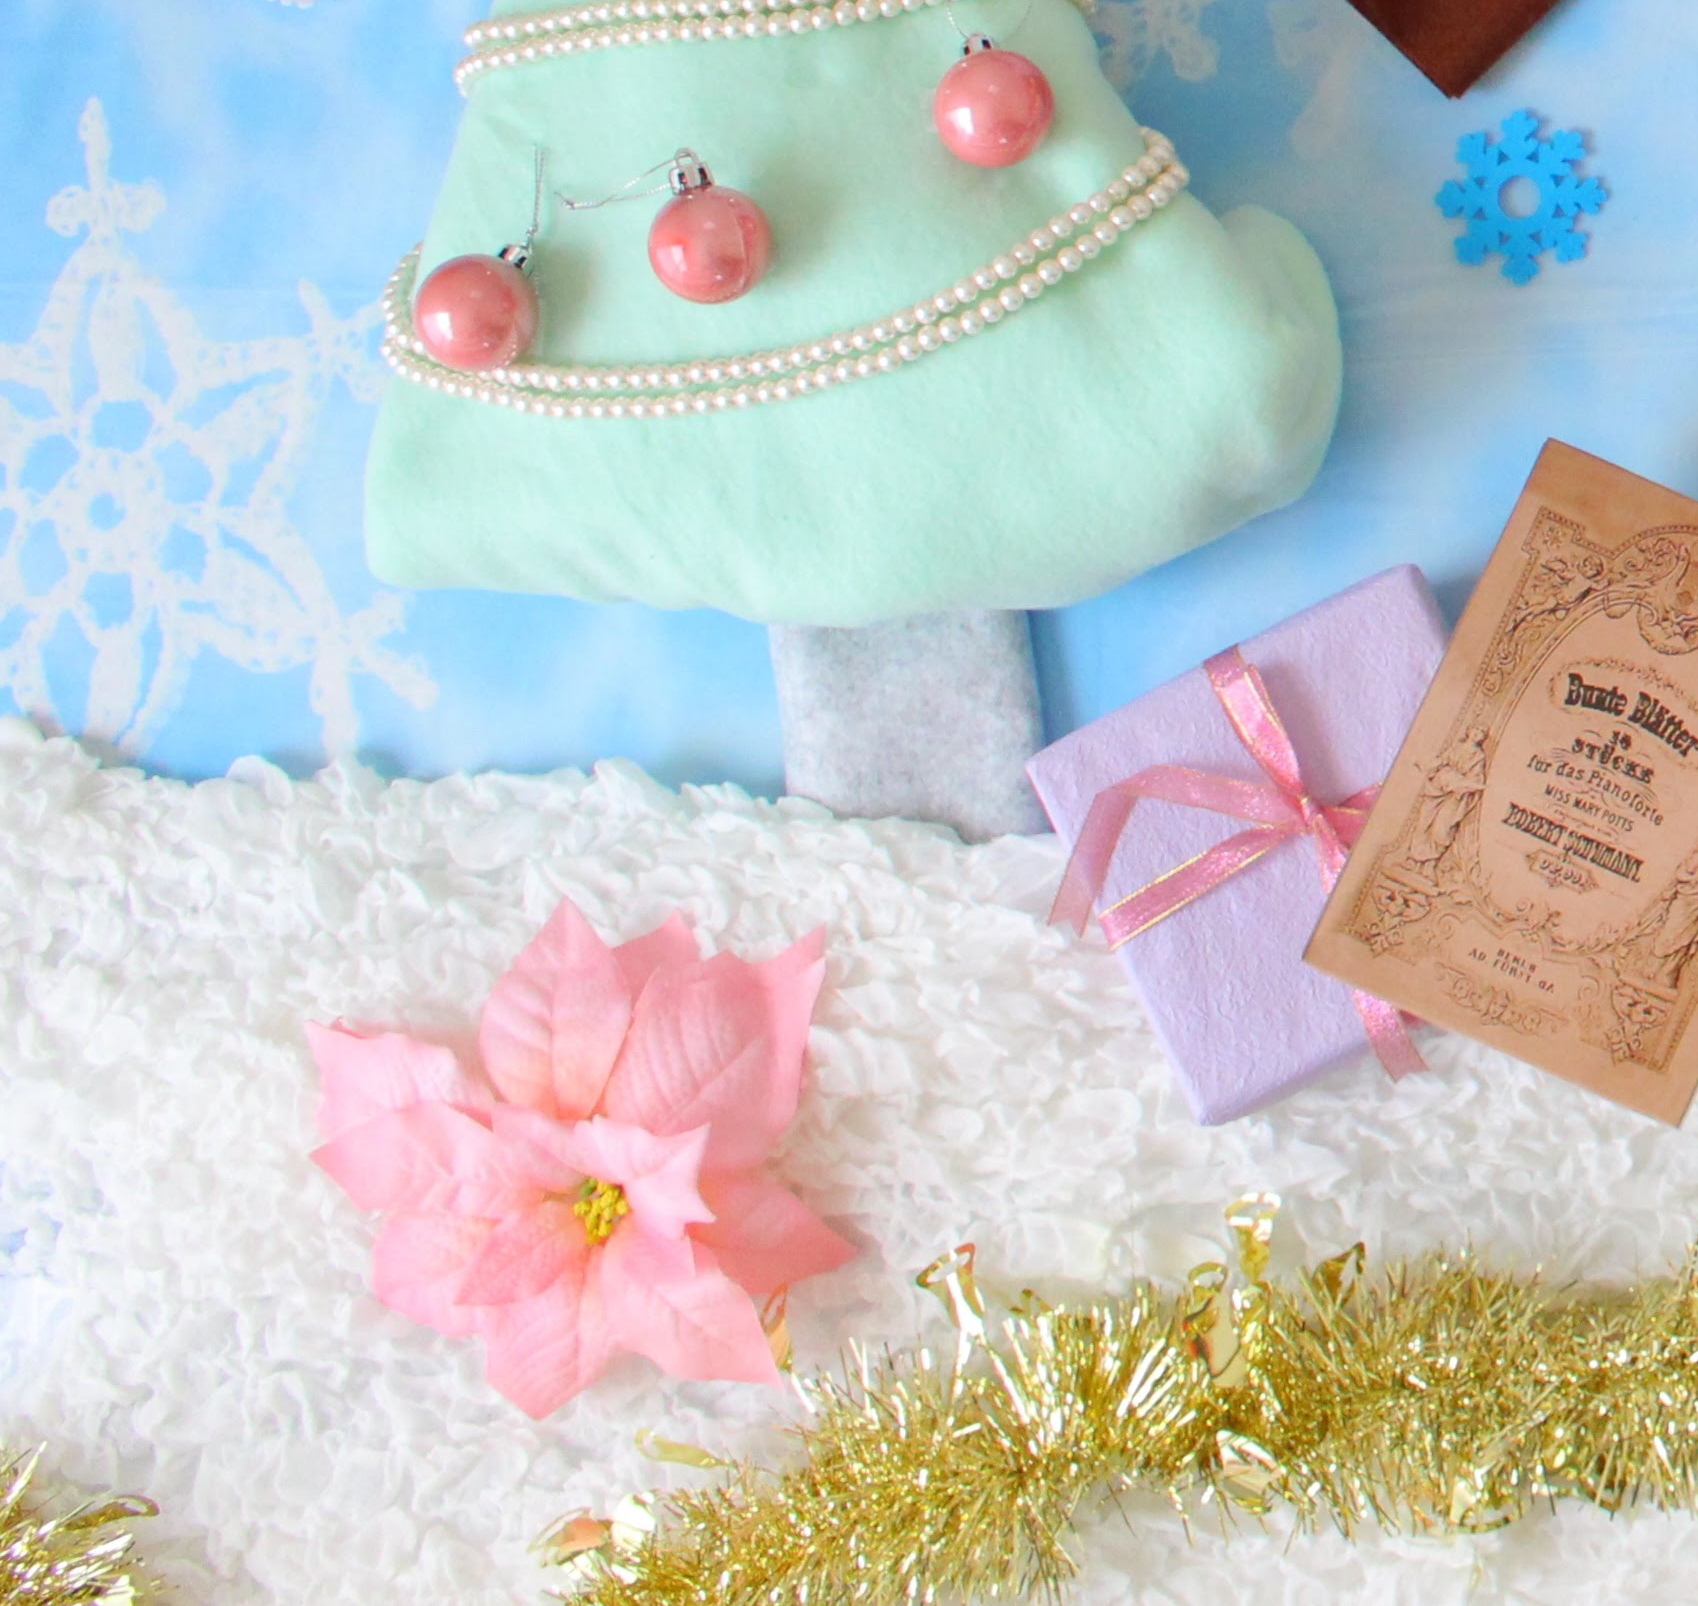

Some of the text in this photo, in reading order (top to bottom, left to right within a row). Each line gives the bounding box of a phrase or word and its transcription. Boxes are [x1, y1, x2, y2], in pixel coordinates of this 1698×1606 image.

[1564, 672, 1628, 717] Bunte
[1544, 783, 1571, 805] MISS
[1573, 797, 1603, 818] MARY
[1600, 808, 1635, 832] POTTS
[1556, 762, 1585, 780] das
[1587, 770, 1664, 826] Pianoforte
[1501, 802, 1568, 846] ROBERT
